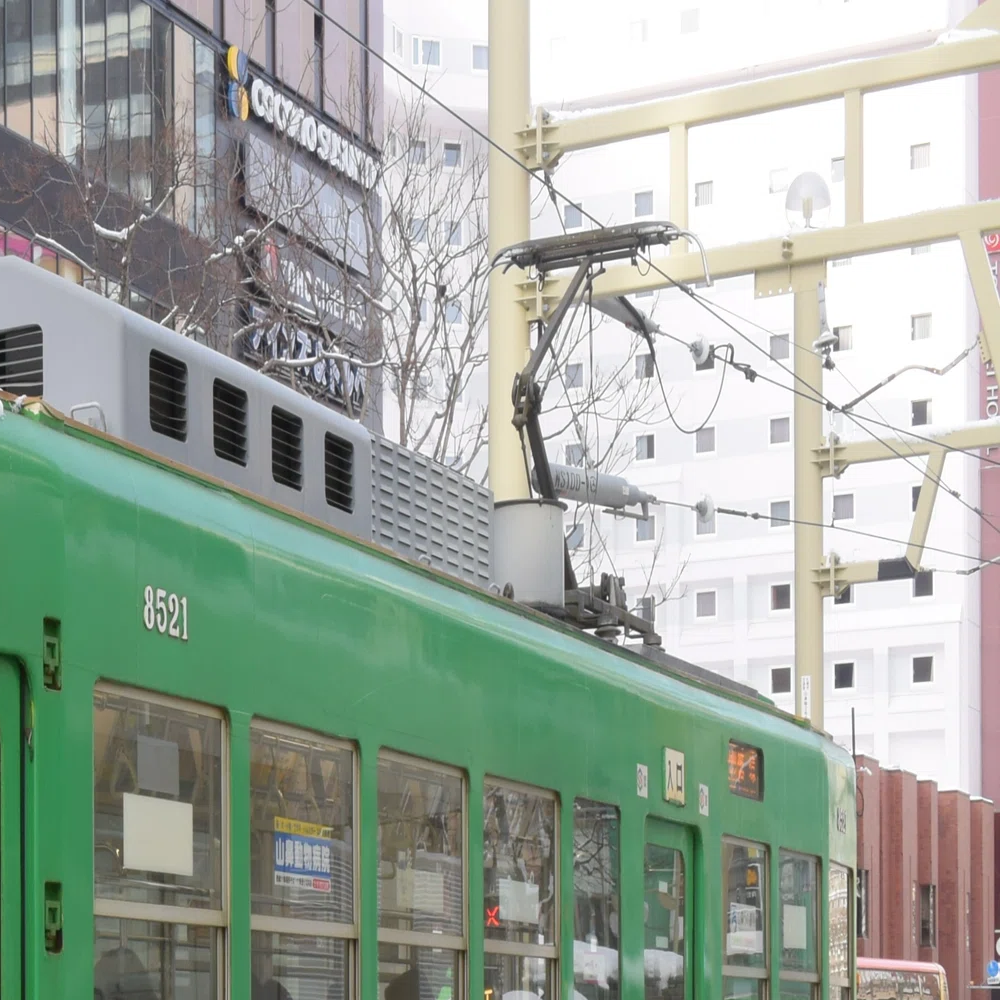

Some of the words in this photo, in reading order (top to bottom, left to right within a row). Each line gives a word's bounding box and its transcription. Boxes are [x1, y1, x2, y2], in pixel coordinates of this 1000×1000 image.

[986, 384, 999, 456] HOL
[144, 585, 189, 641] 8521
[667, 760, 683, 793] 入口
